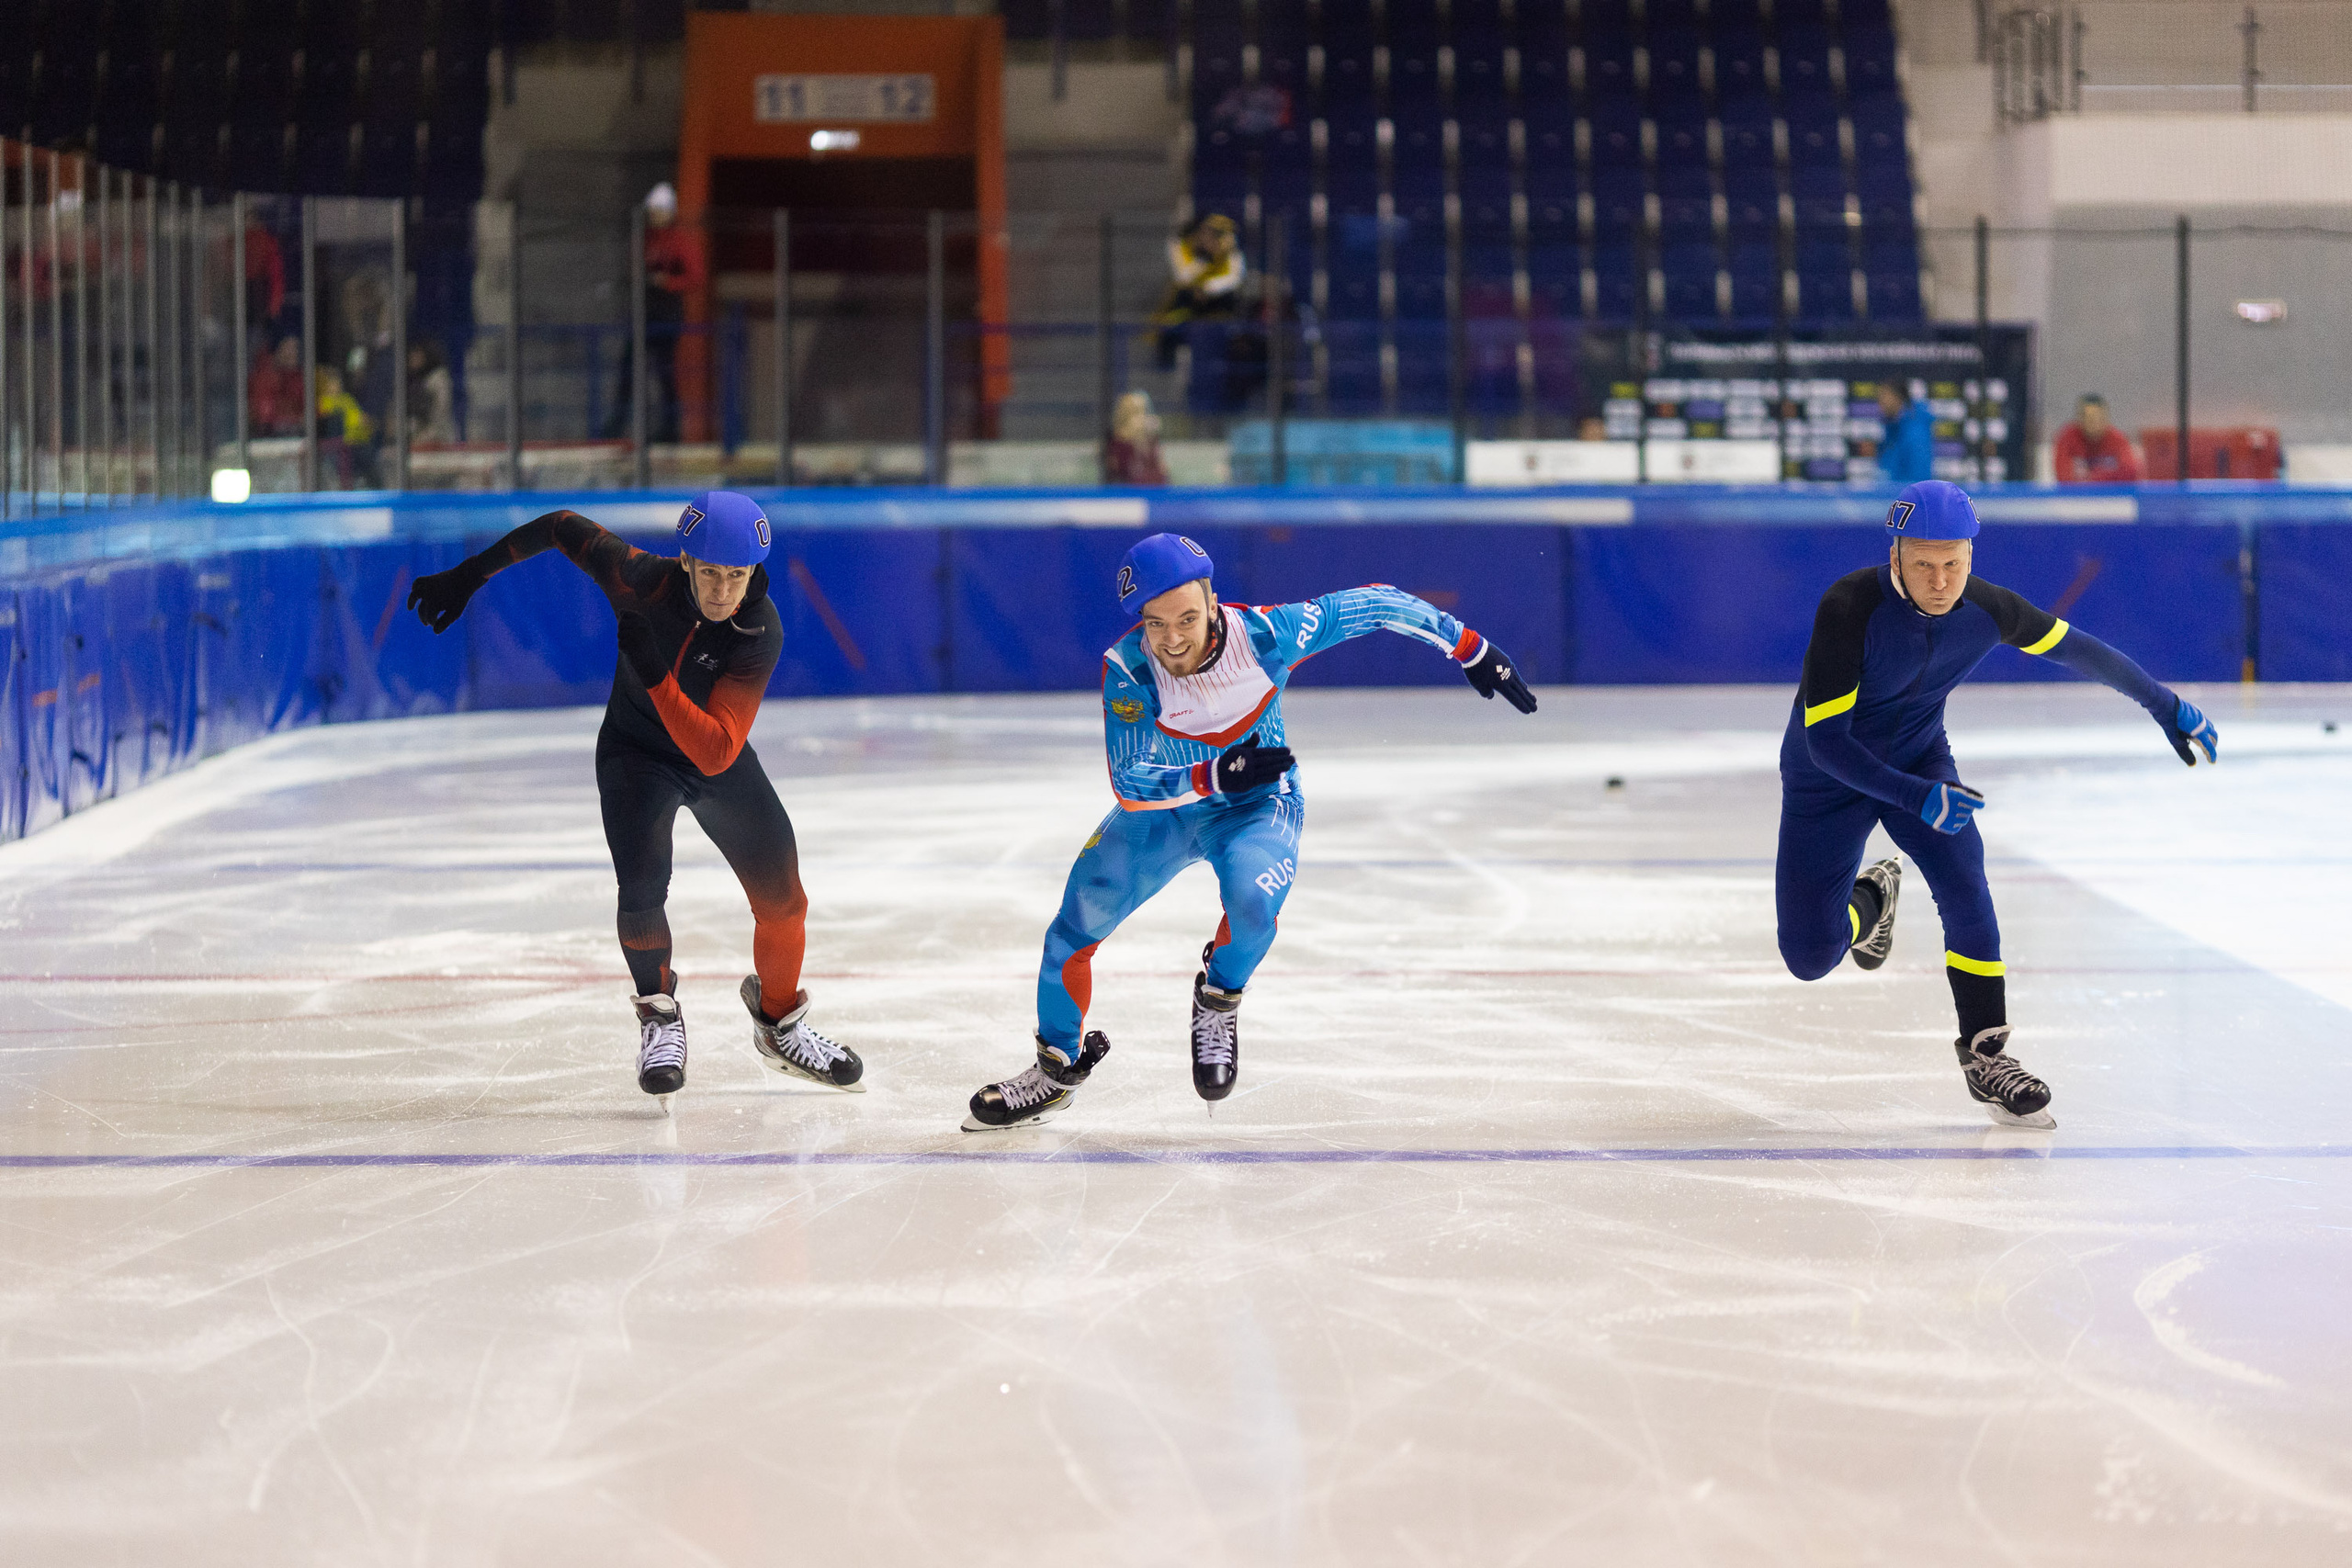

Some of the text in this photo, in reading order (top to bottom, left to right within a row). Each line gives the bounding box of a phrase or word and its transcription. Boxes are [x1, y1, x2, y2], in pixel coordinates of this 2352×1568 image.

[763, 81, 807, 117] 11
[879, 77, 927, 116] 12
[1296, 601, 1321, 649] RUS
[1255, 858, 1295, 897] RUS
